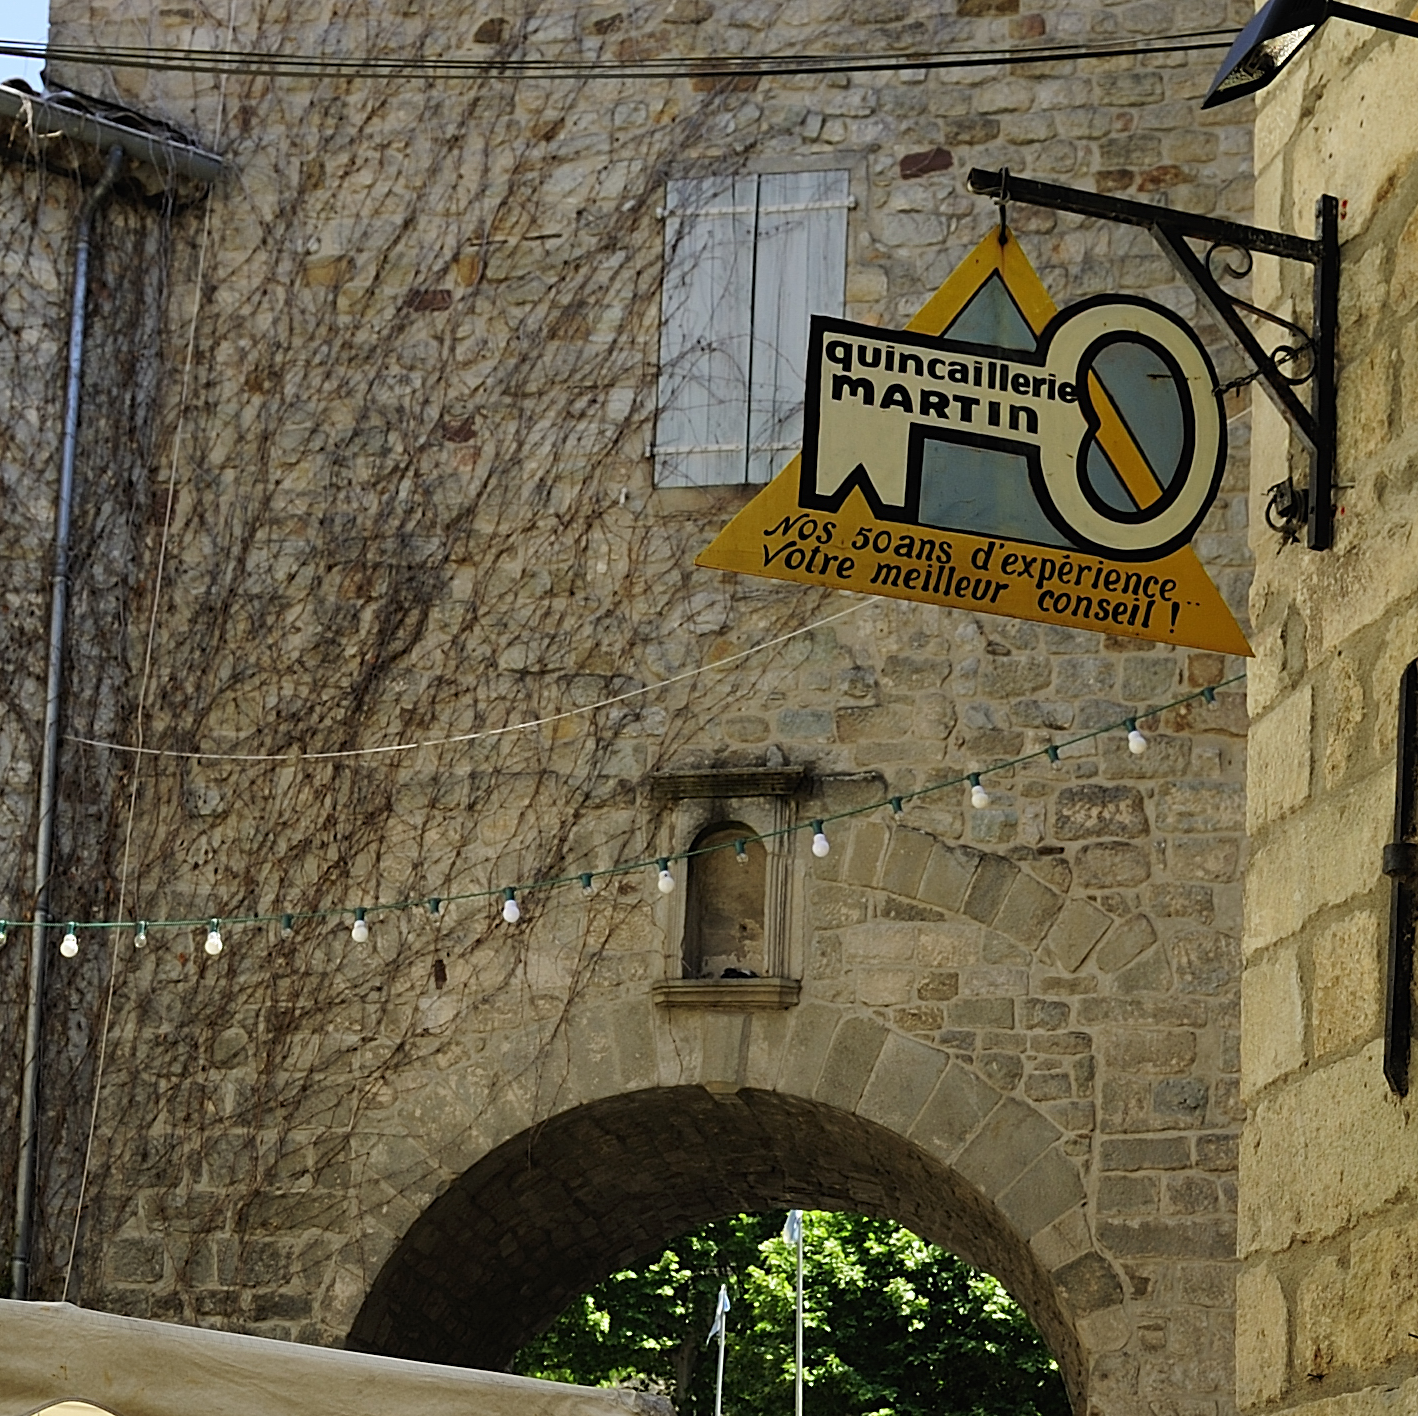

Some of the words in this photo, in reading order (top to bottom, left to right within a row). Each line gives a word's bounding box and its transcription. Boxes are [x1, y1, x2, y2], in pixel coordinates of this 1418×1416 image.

[825, 339, 1078, 404] quincaillerie
[763, 513, 835, 545] Nos
[763, 541, 855, 579] Votre
[870, 562, 1010, 605] meilleur
[1037, 589, 1156, 629] conseil
